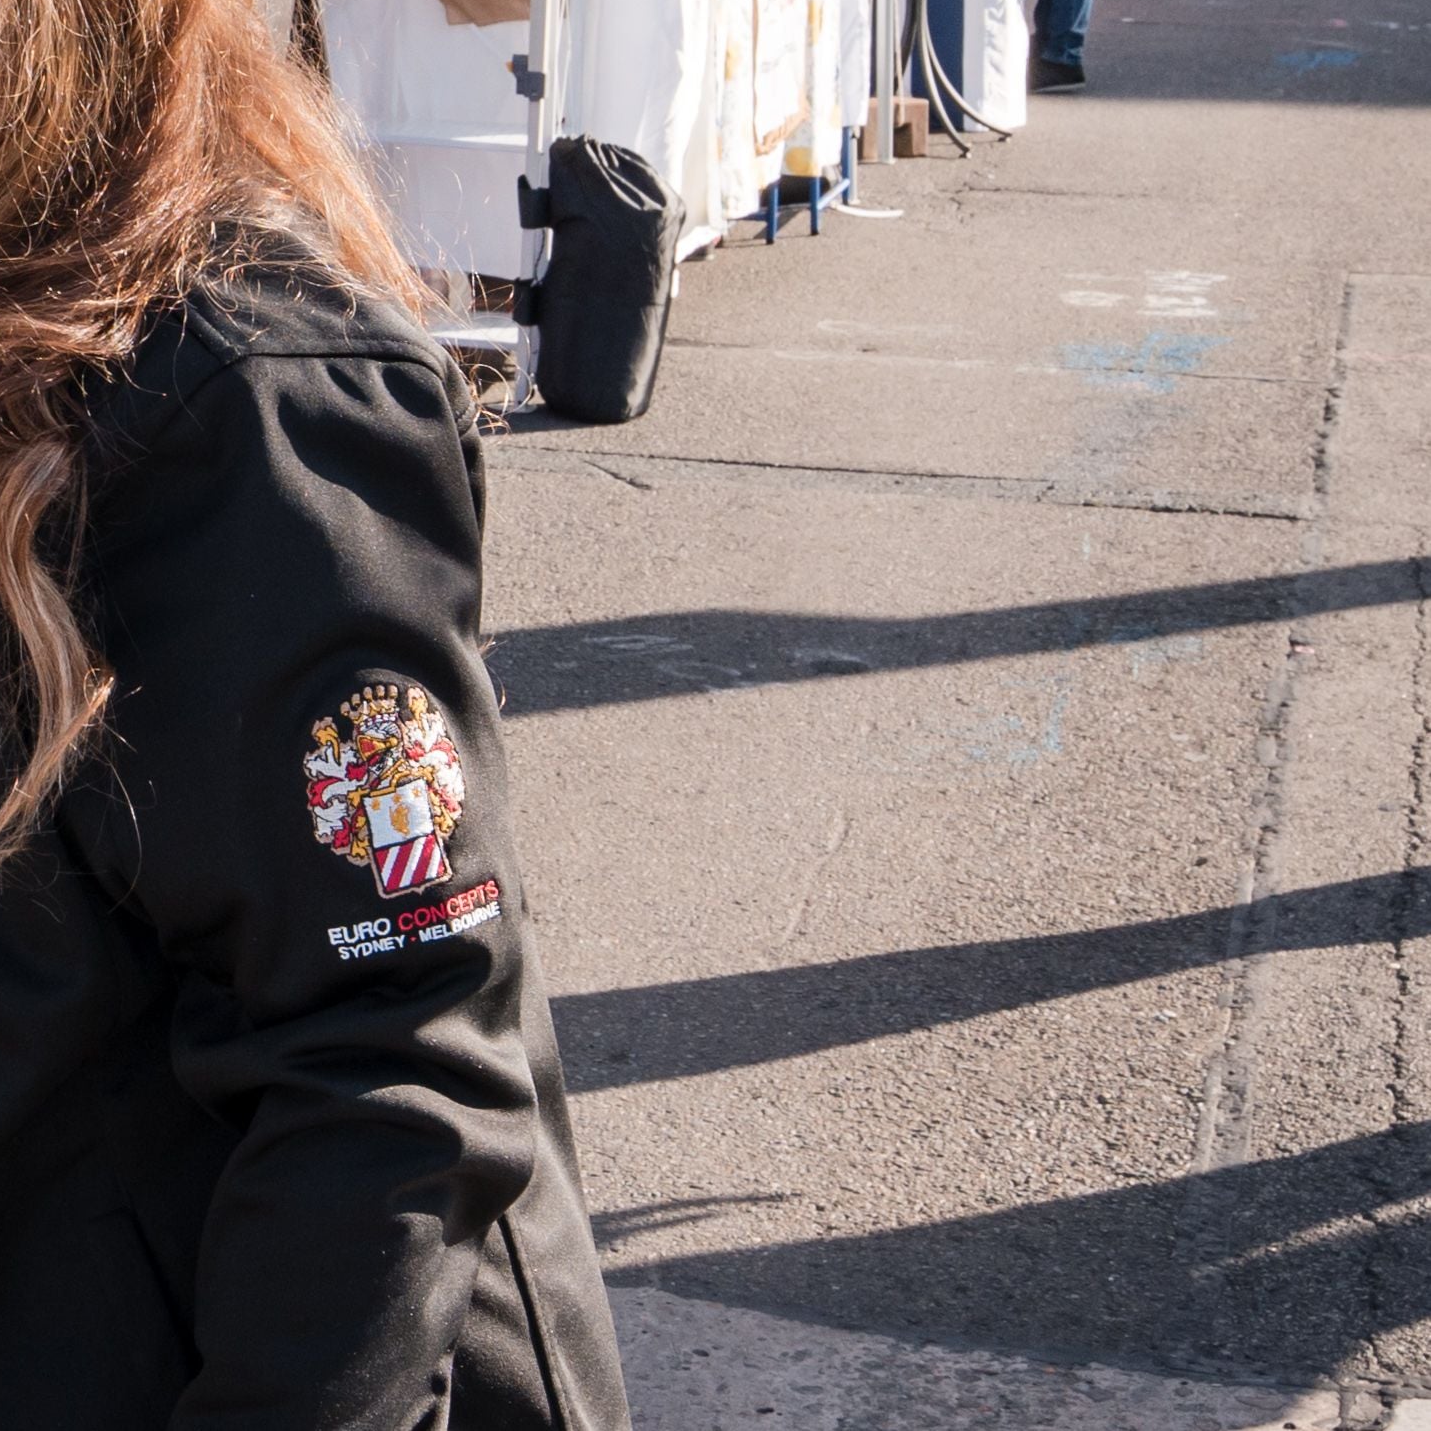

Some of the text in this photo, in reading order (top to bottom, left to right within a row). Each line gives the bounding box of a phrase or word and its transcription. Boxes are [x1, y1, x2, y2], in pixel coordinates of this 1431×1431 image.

[327, 879, 500, 946] EURO CONCEPTS
[338, 900, 501, 960] SYDNEY MELBOURNE
